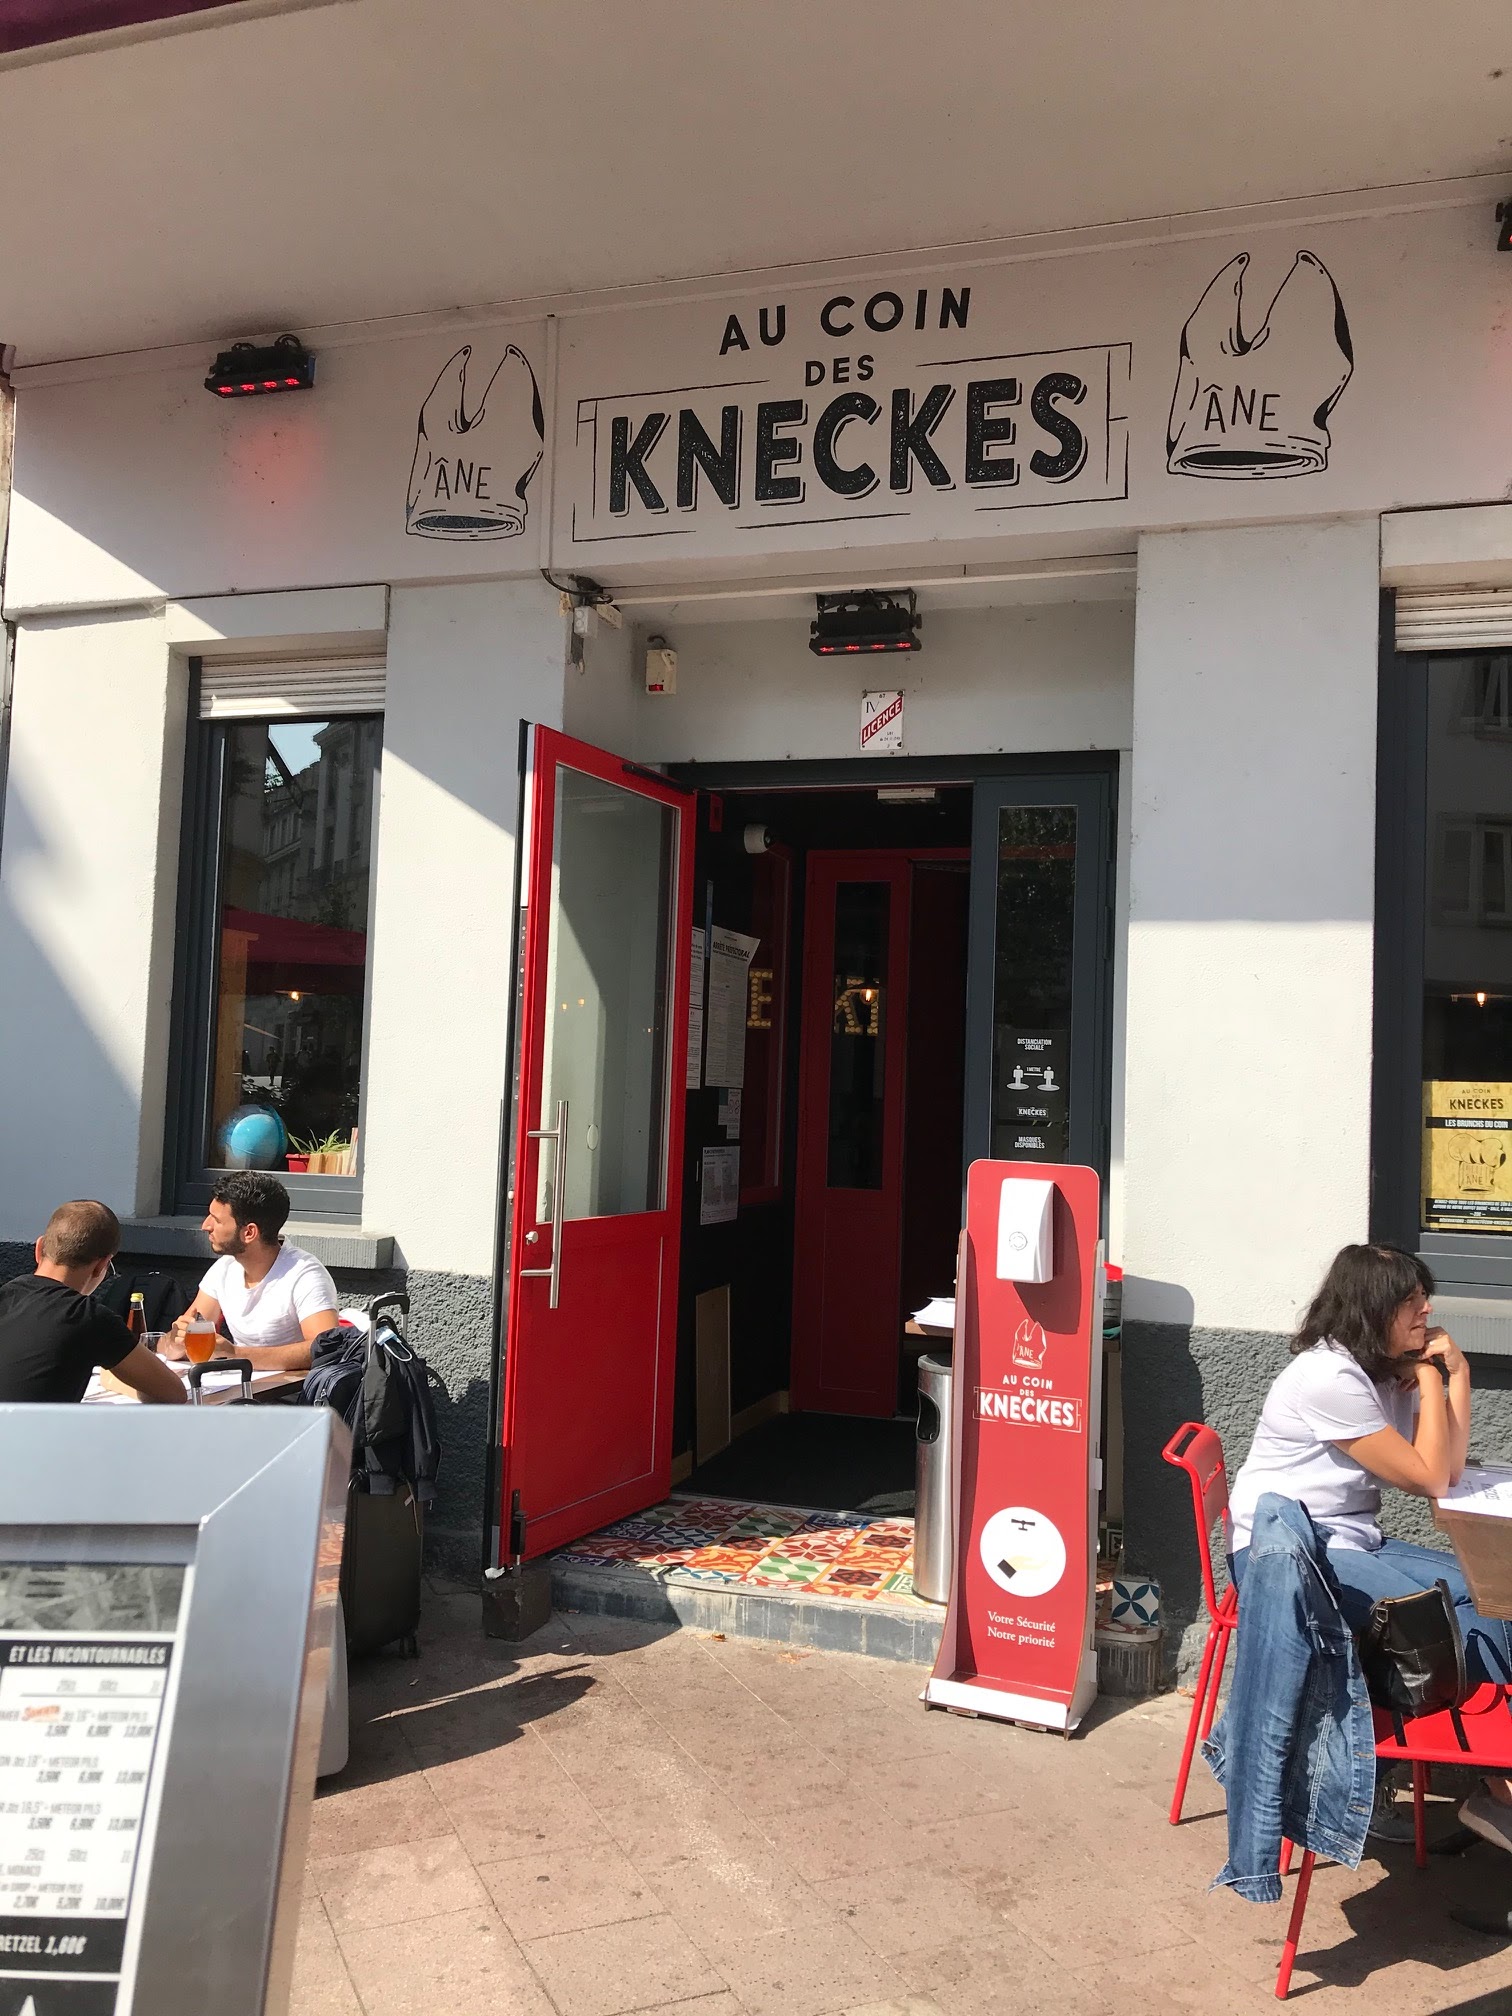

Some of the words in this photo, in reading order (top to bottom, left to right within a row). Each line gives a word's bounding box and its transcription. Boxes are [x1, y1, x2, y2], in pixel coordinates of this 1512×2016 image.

[719, 304, 786, 356] AU
[820, 287, 971, 337] COIN
[805, 354, 874, 387] DES
[1203, 384, 1280, 433] ÂNE
[609, 372, 1087, 517] KNECKES
[435, 457, 491, 500] ÂNE
[866, 701, 880, 713] IV
[863, 699, 902, 742] LICENCE
[1017, 1038, 1052, 1046] DISTANCIATION
[1018, 1108, 1047, 1117] KNECKES
[1449, 1098, 1504, 1110] KNECKES
[1445, 1119, 1456, 1127] LES
[1002, 1375, 1018, 1385] AU
[1022, 1376, 1053, 1390] COIN
[1019, 1389, 1035, 1397] DES
[980, 1391, 1075, 1427] KNECKES
[987, 1610, 1014, 1625] Votre
[1016, 1615, 1056, 1633] Sécurité
[987, 1626, 1016, 1641] Notre
[1018, 1634, 1055, 1648] priorité
[9, 1645, 25, 1662] ET
[27, 1645, 51, 1663] LES
[52, 1646, 167, 1664] INCONTOURNABLES
